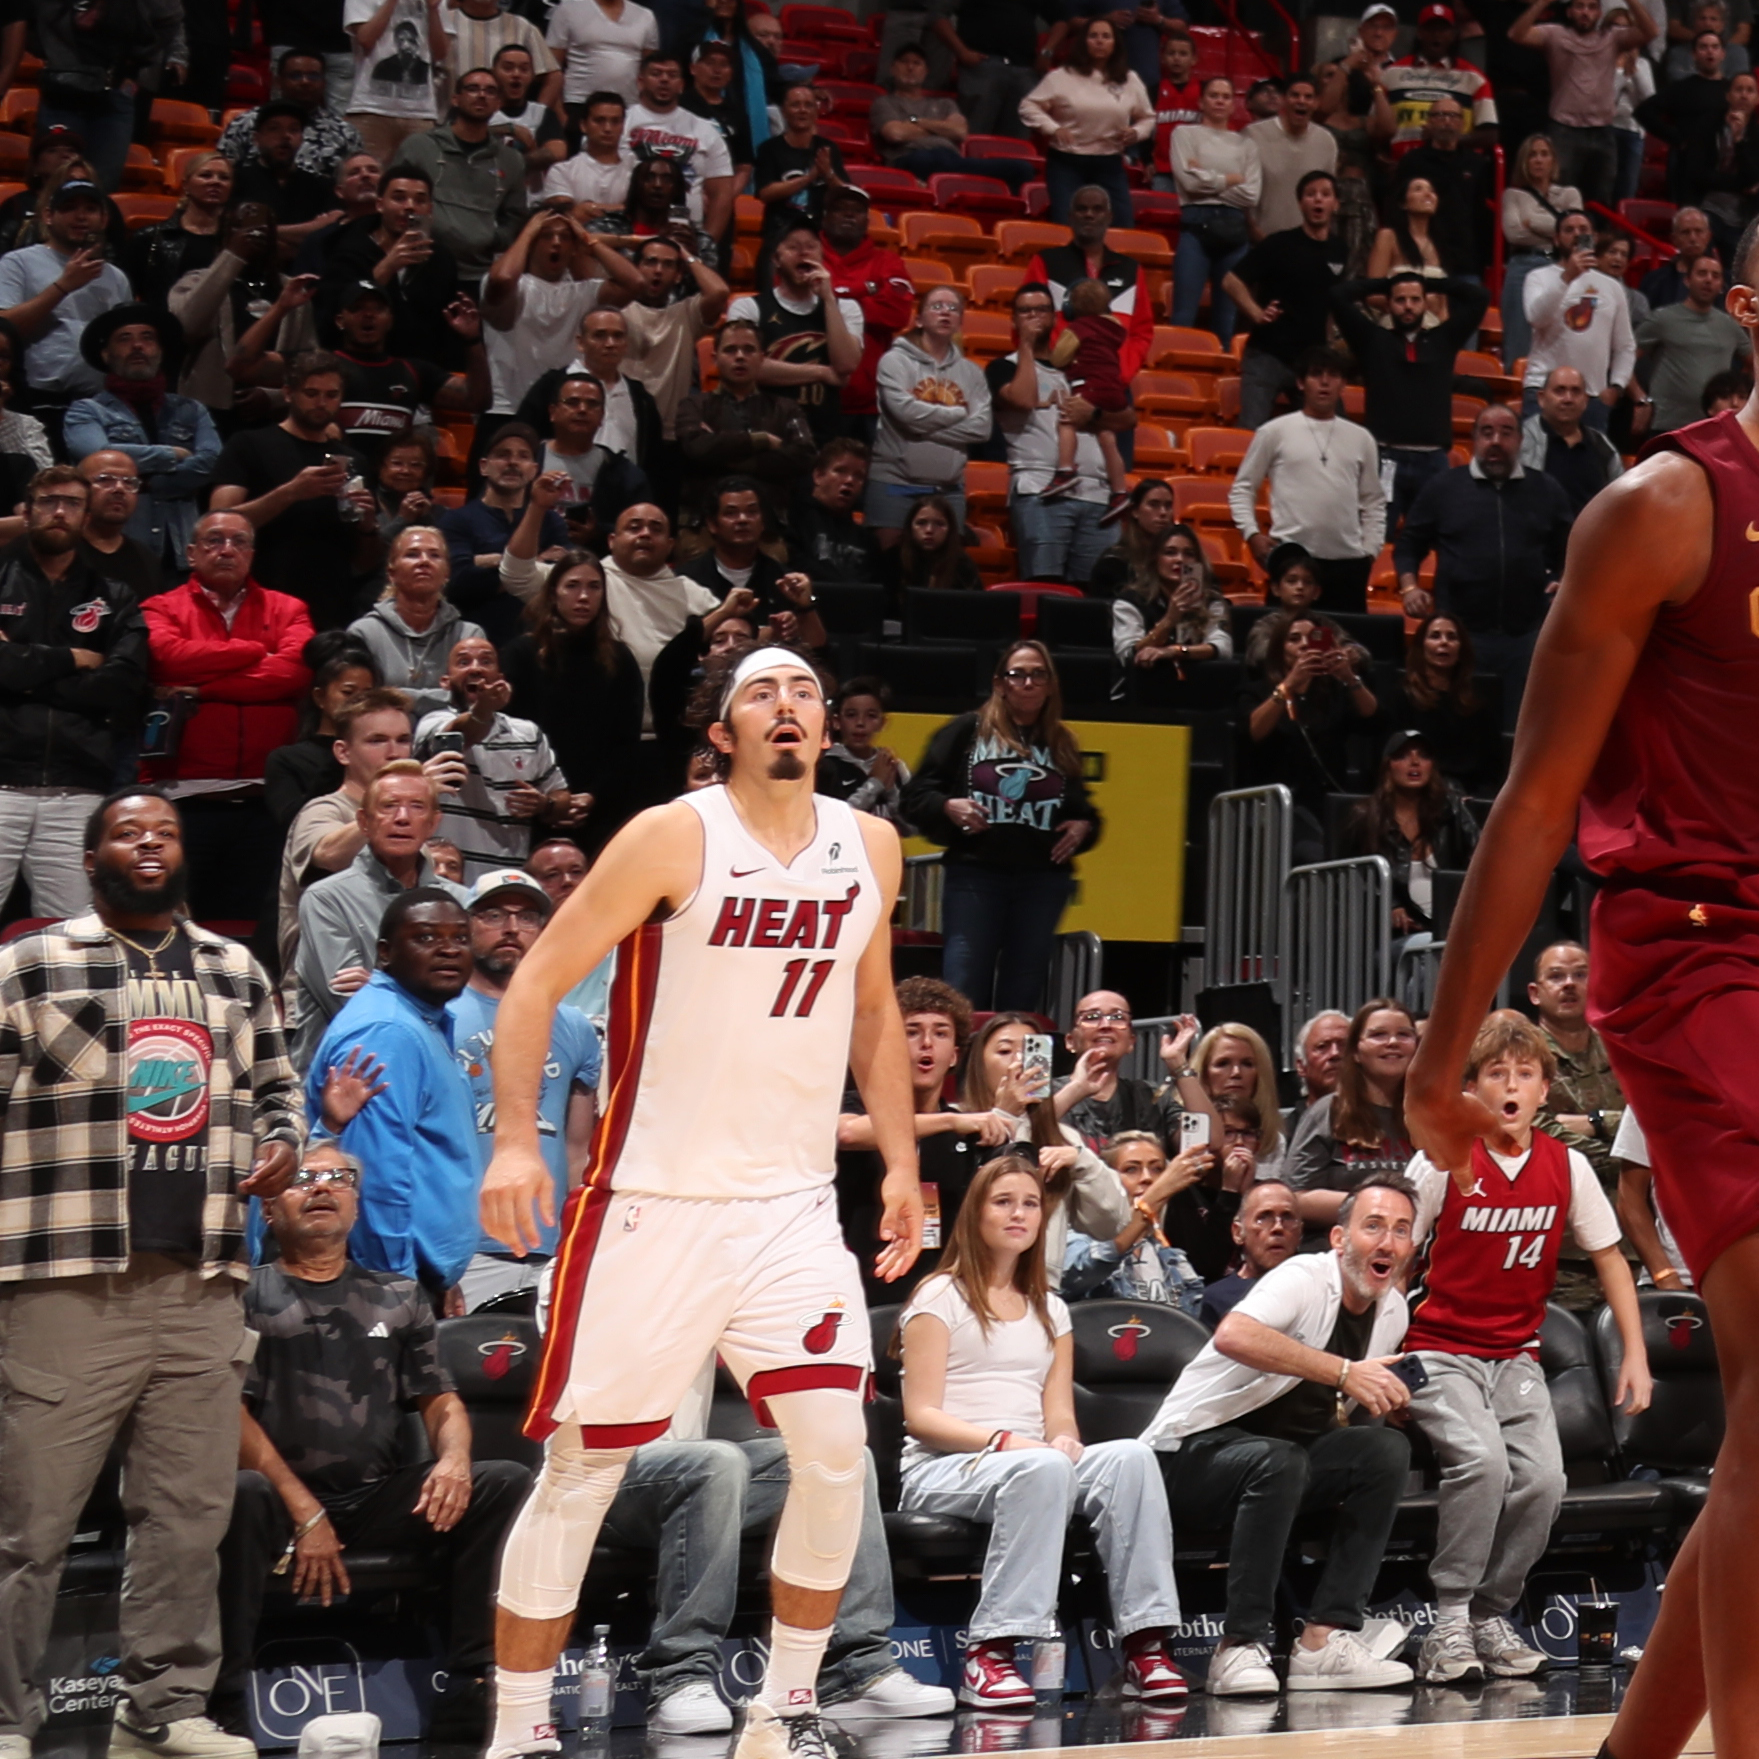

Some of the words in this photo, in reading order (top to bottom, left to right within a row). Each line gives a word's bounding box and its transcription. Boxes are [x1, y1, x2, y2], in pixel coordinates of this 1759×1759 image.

[974, 795, 1061, 832] HEAT
[707, 879, 861, 949] HEAT
[770, 956, 837, 1018] 11
[130, 1059, 199, 1089] NIKE
[1460, 1204, 1558, 1234] MIAMI
[1502, 1233, 1547, 1270] 14
[50, 1673, 122, 1696] Kaseya
[268, 1664, 359, 1716] ONE
[50, 1693, 121, 1715] Center
